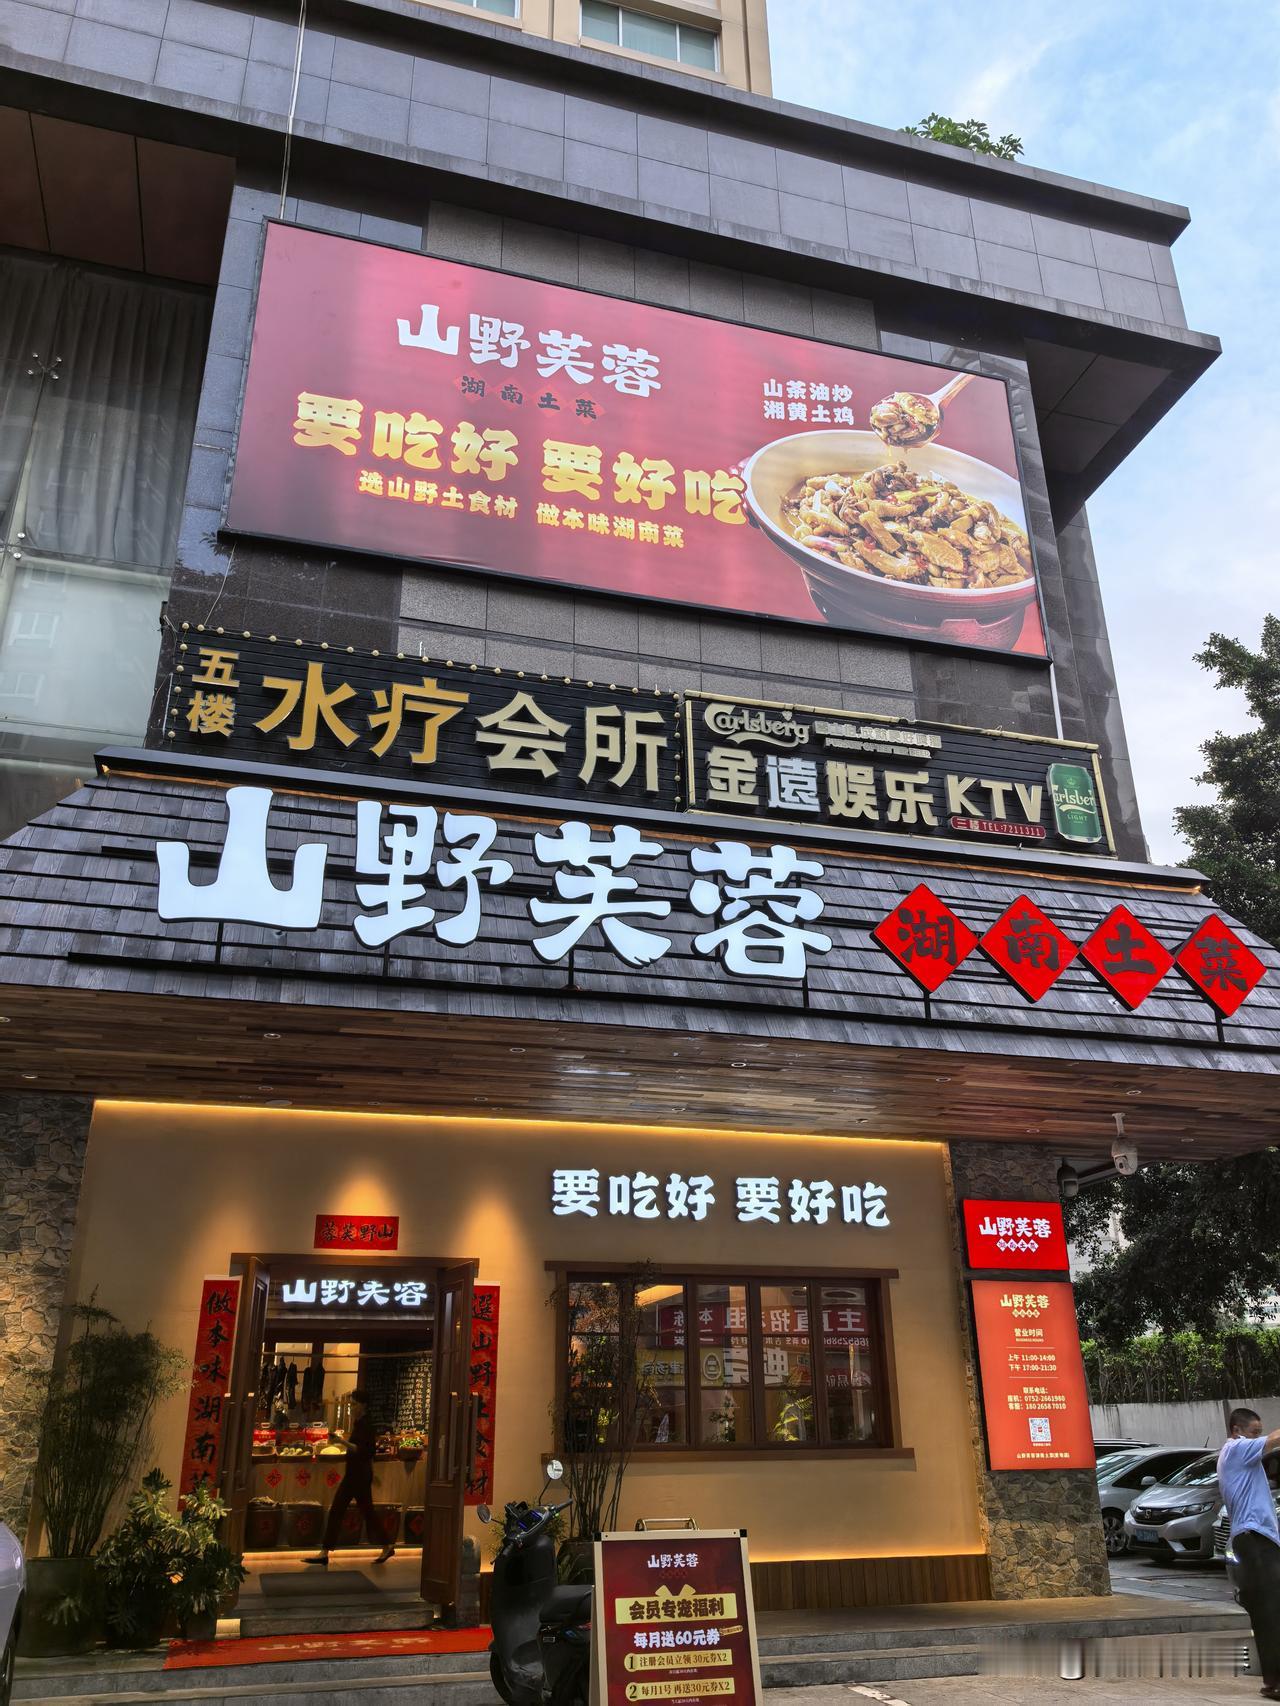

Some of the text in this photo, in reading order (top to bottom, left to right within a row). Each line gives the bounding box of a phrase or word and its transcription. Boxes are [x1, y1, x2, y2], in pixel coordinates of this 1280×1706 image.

[397, 303, 662, 398] 山野芙蓉
[461, 375, 598, 420] 湖南土菜
[763, 378, 853, 403] 山茶油炒
[763, 400, 855, 426] 湘黄土鸡
[293, 391, 747, 525] 要吃好 要好吃
[358, 470, 686, 548] 选山野土食材 做本味湖南菜
[186, 647, 241, 738] 五楼
[253, 661, 669, 792] 水疗会所
[705, 703, 811, 748] Carlsberg
[983, 822, 1041, 836] TEL:7211311
[156, 785, 833, 979] 山野芙蓉
[897, 908, 1249, 991] 湖南土菜
[552, 1168, 891, 1227] 要吃好 要好吃
[979, 1216, 1051, 1239] 山野芙蓉
[1000, 1294, 1050, 1309] 山野芙蓉
[1014, 1328, 1044, 1338] 营业时间
[1008, 1354, 1056, 1362] 上午 11:00-14:00
[1008, 1364, 1057, 1372] 下午 17:00-21:30
[647, 1553, 699, 1568] 山野芙蓉
[629, 1597, 725, 1621] 会员专宠福利
[633, 1628, 721, 1649] 每月送60元券
[628, 1652, 728, 1670] 1 注册会员立领 30元券X2
[629, 1684, 638, 1700] 2
[641, 1684, 672, 1696] 每月1号
